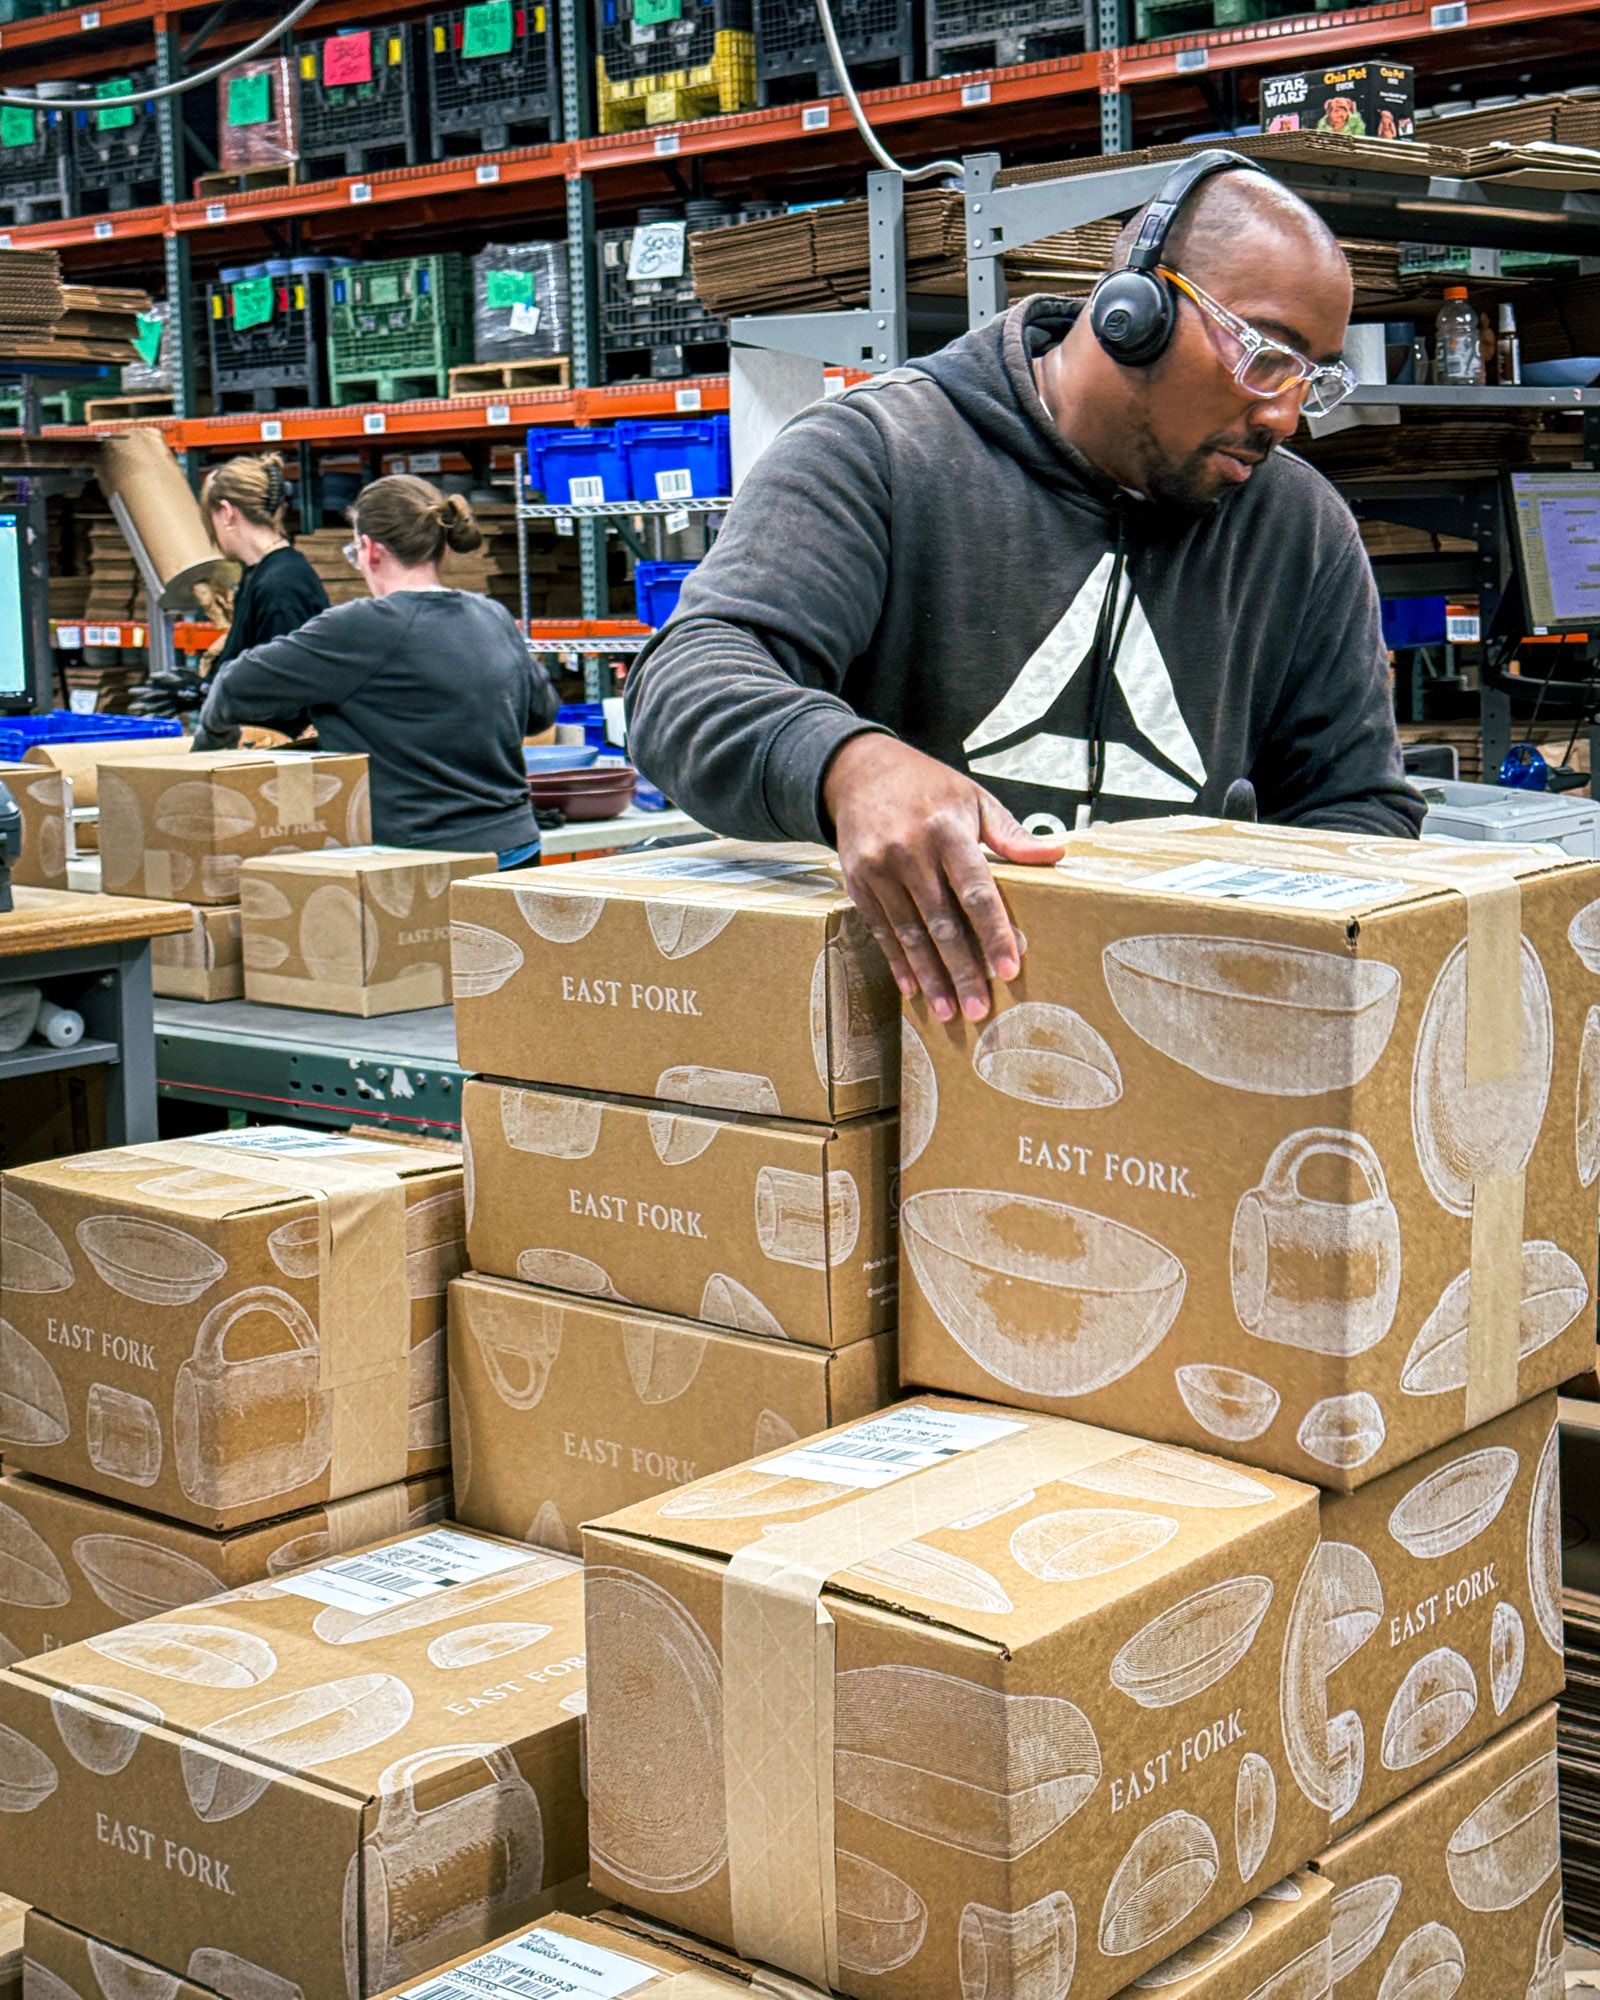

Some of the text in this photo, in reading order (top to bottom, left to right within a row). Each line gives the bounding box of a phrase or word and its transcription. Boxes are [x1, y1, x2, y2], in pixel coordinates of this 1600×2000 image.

[1268, 78, 1308, 94] STAR
[1323, 68, 1367, 85] Chia Pet
[1264, 90, 1308, 108] WARS
[259, 825, 290, 839] EAST
[398, 929, 430, 945] EAST
[562, 976, 622, 1007] EAST
[1018, 1135, 1092, 1176] EAST
[569, 1189, 628, 1223] EAST
[47, 1317, 95, 1352] EAST
[563, 1431, 623, 1468] EAST
[1391, 1594, 1439, 1648] EAST
[443, 1653, 586, 1716] EAST FOR
[1110, 1750, 1173, 1814] EAST
[96, 1811, 155, 1860] EAST
